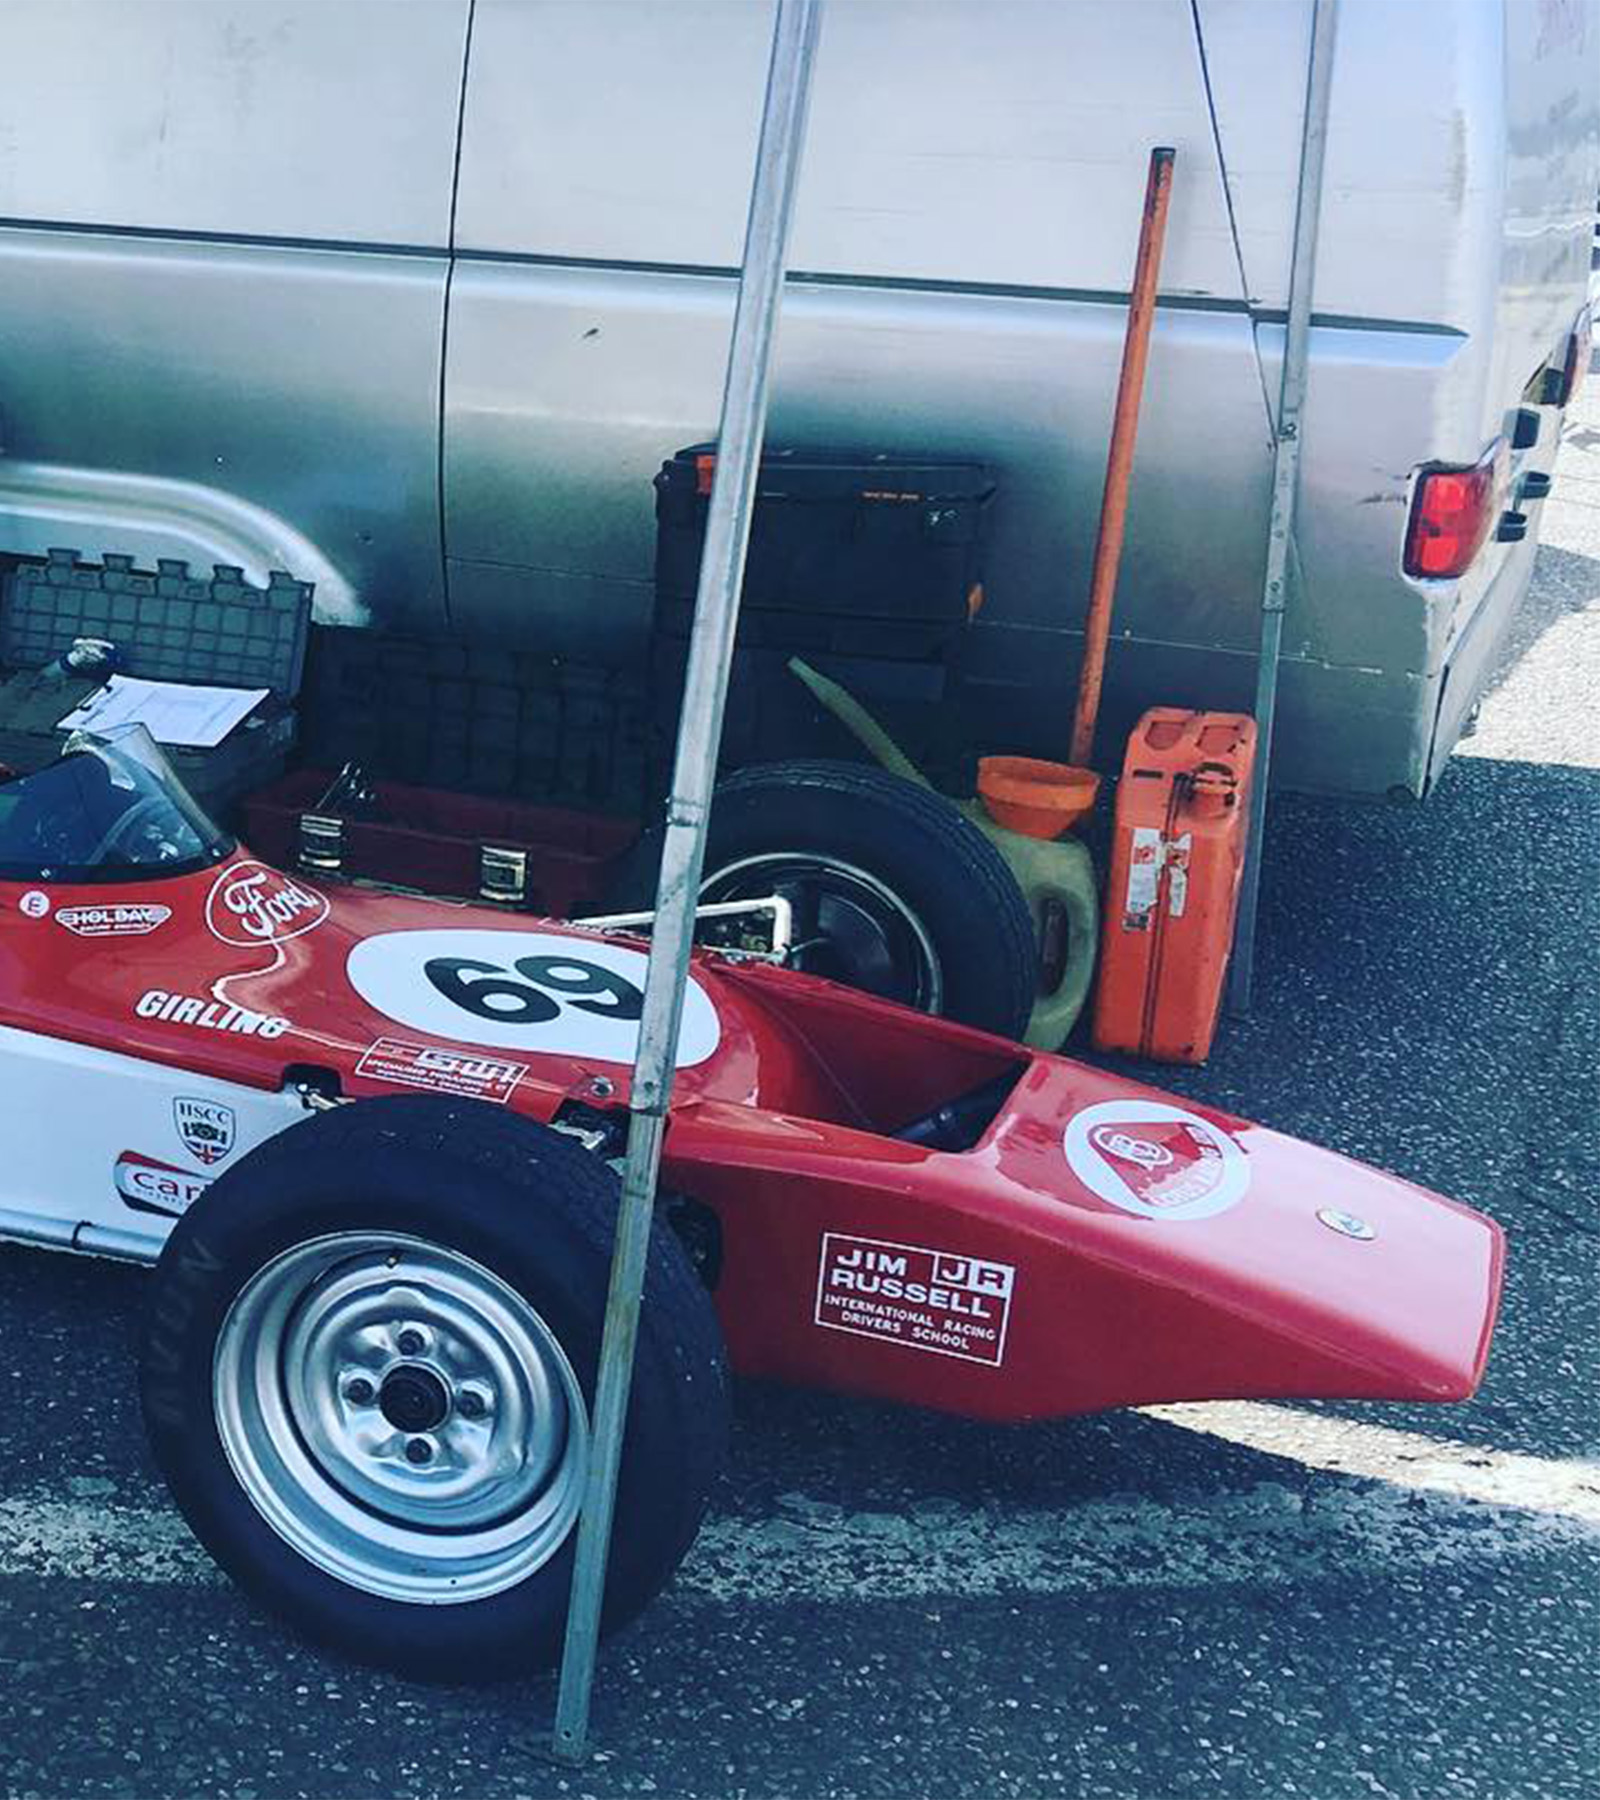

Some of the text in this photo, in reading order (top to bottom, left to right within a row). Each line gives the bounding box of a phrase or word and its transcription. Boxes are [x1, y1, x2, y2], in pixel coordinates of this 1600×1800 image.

[223, 872, 321, 937] Ford
[134, 989, 291, 1039] GIRLING
[423, 955, 645, 1025] 69
[179, 1102, 230, 1125] HSCC
[836, 1249, 908, 1277] JIM
[824, 1293, 997, 1342] INTERNATIONAL RACING
[830, 1267, 992, 1319] RUSSELL
[841, 1310, 970, 1350] DRIVERS SCHOOL
